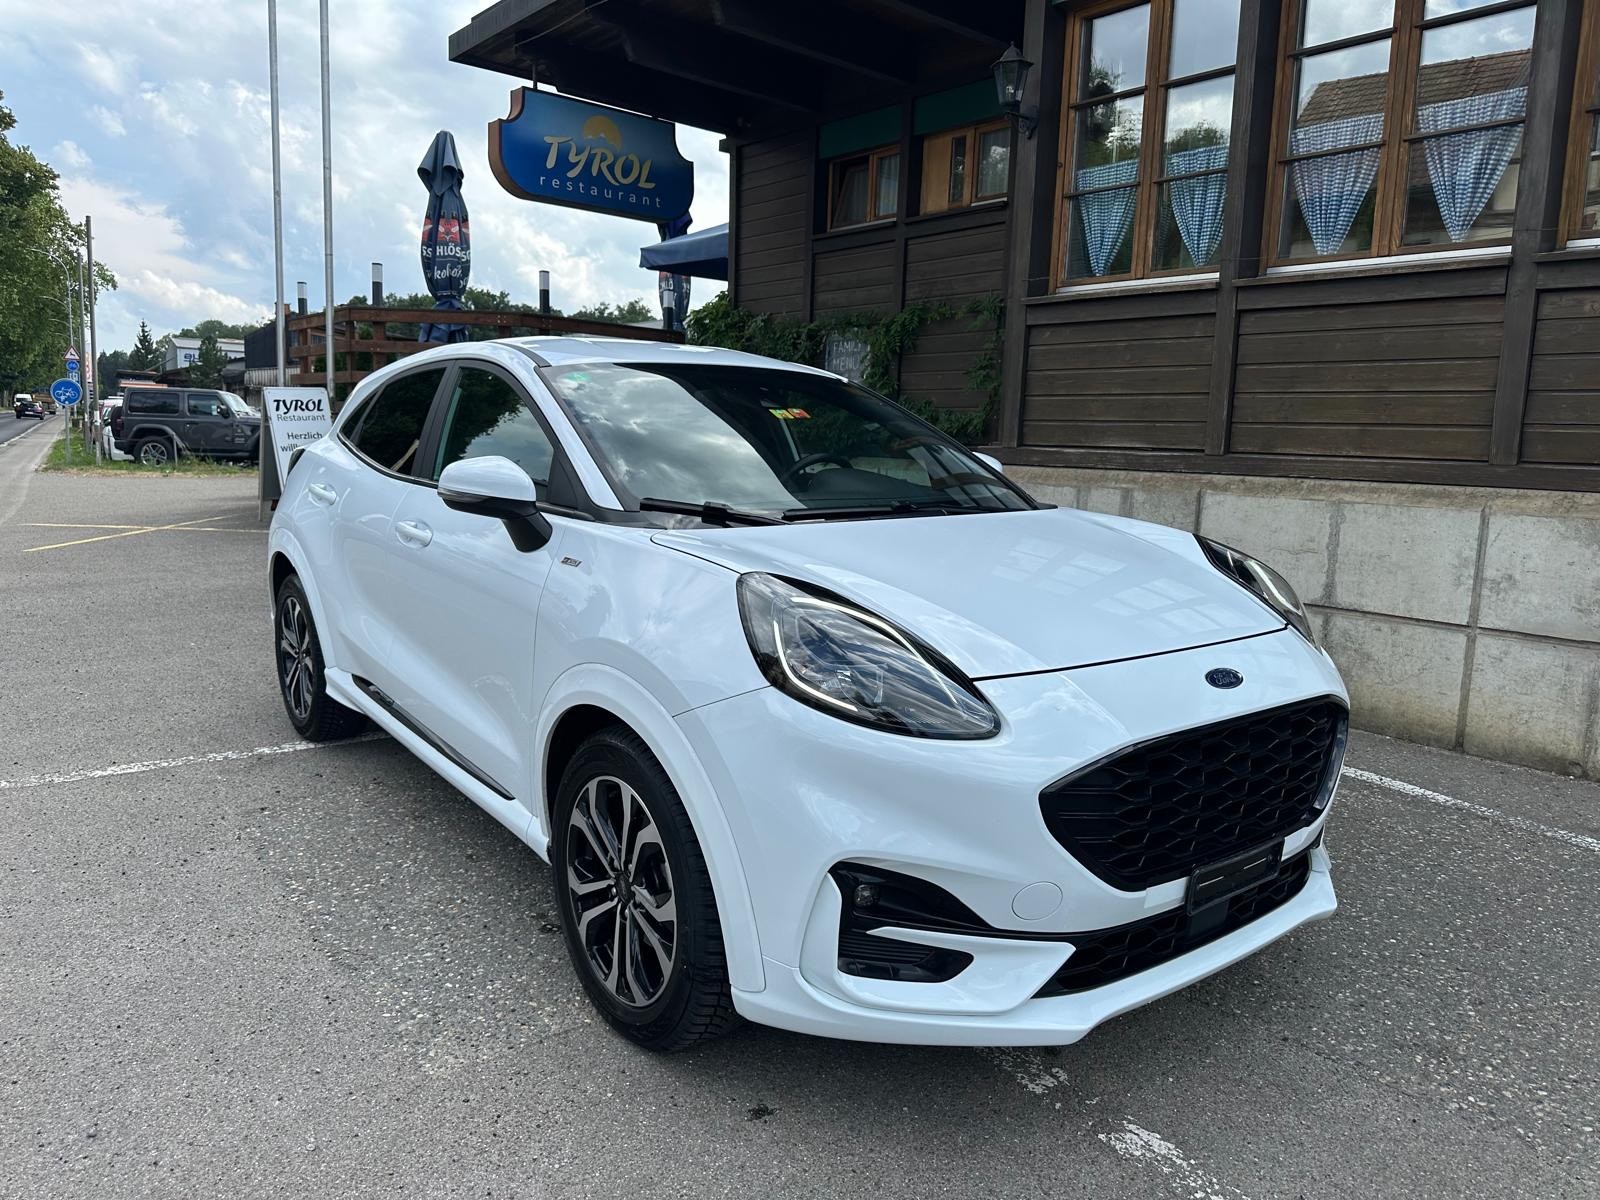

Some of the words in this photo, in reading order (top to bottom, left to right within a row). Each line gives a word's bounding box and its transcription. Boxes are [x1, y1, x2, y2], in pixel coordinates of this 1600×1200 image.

[543, 135, 656, 189] TYROL
[539, 175, 662, 208] restaurant
[273, 398, 324, 415] TYROL
[287, 432, 323, 440] Herzlich
